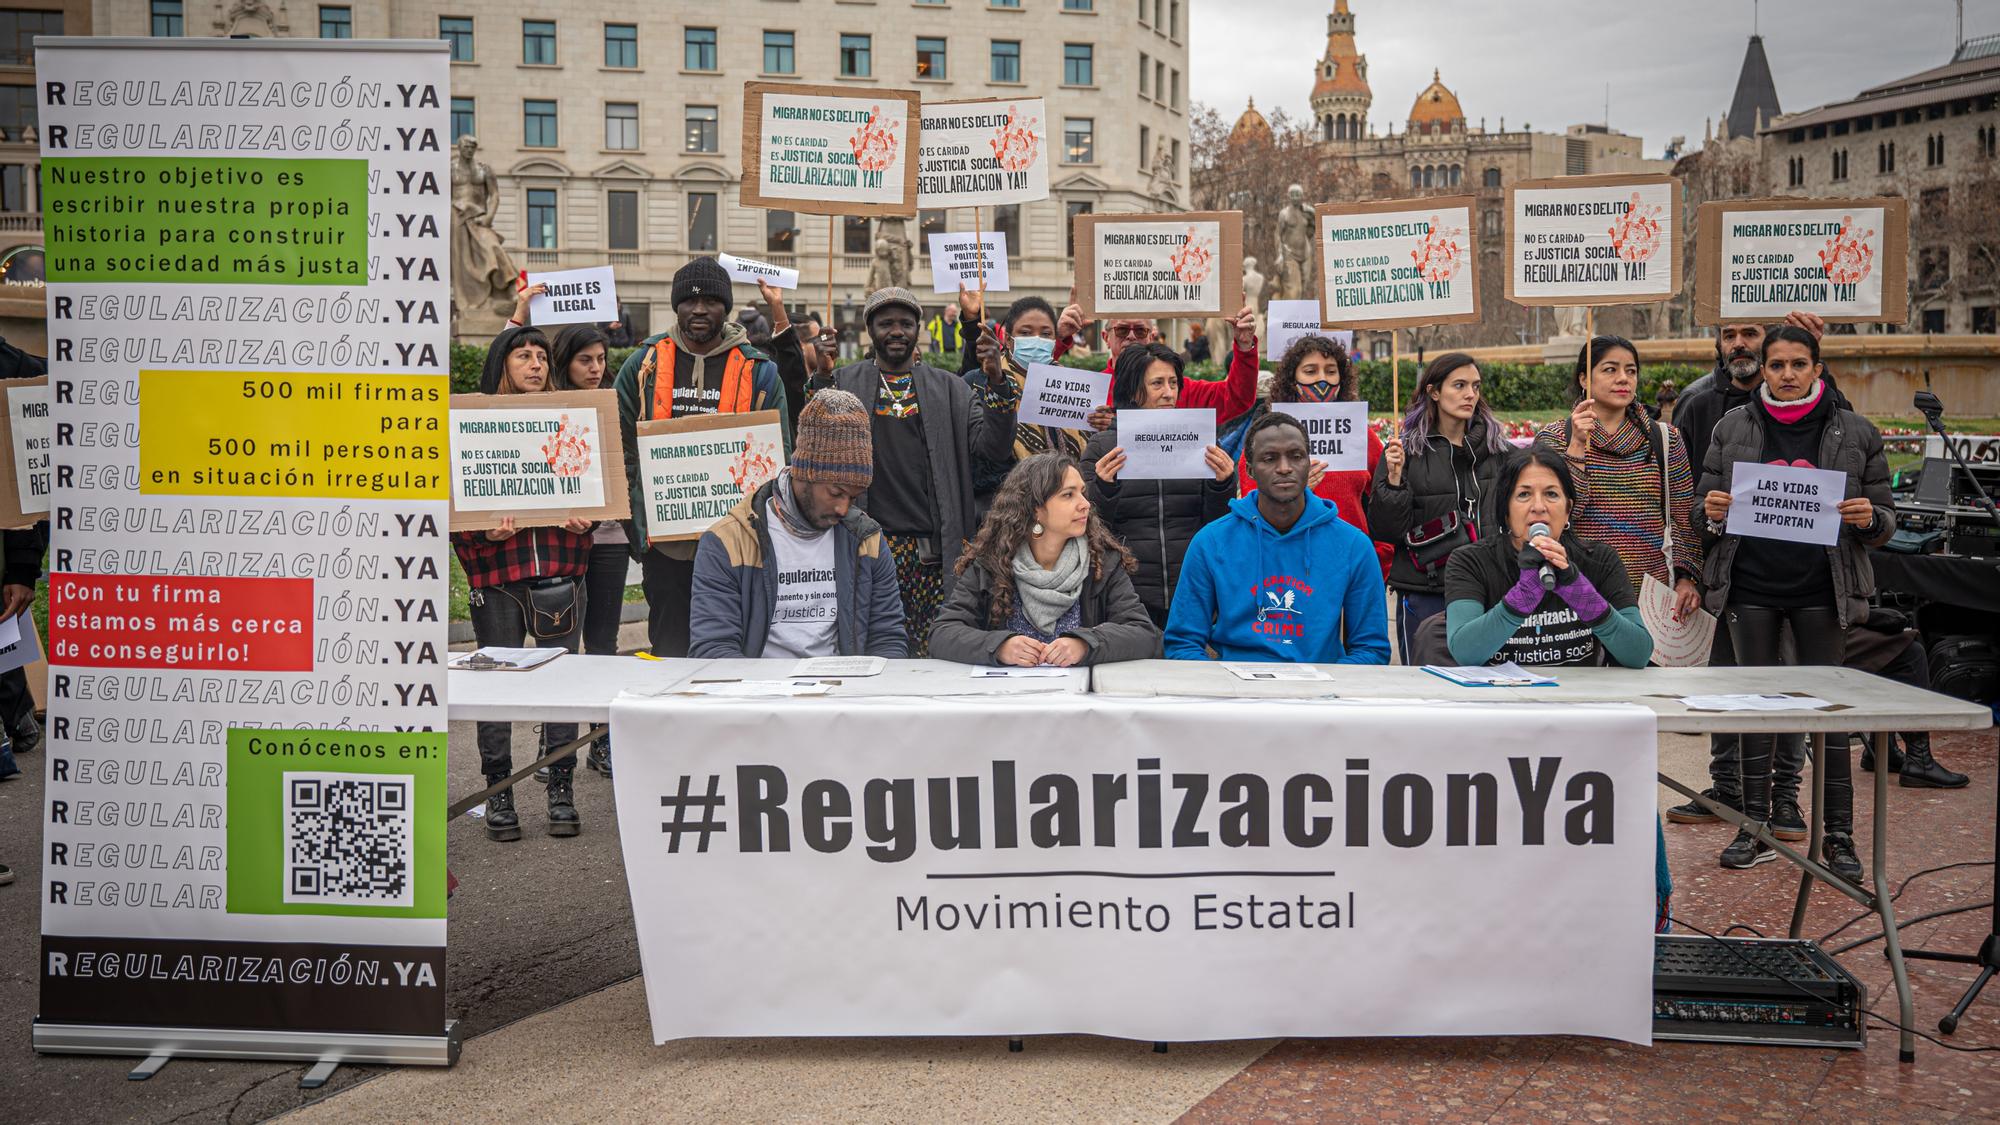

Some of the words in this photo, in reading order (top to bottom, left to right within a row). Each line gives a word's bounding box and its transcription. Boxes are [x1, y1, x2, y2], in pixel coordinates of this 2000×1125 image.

[46, 76, 440, 109] REGULARIZACIÓN.YA
[773, 106, 808, 120] MIGRAR
[809, 108, 822, 120] NO
[823, 109, 835, 121] ES
[837, 110, 870, 123] DELITO
[48, 119, 440, 152] REGULARIZACIÓN.YA
[771, 136, 782, 145] NO
[784, 136, 792, 145] ES
[795, 137, 828, 147] CARIDAD
[771, 151, 779, 160] ES
[781, 149, 823, 163] JUSTICIA
[827, 152, 861, 165] SOCIAL
[51, 166, 146, 185] Nuestro
[159, 166, 263, 189] objetivo
[277, 172, 304, 186] es
[770, 165, 857, 187] REGULARIZACION
[863, 170, 883, 189] YA!!
[52, 195, 145, 214] escribir
[158, 197, 255, 214] nuestra
[270, 197, 349, 219] propia
[1525, 203, 1563, 216] MIGRAR
[1564, 203, 1577, 215] NO
[1579, 203, 1592, 215] ES
[1594, 202, 1629, 215] DELITO
[53, 224, 145, 243] historia
[159, 228, 215, 247] para
[228, 227, 345, 245] construir
[1105, 234, 1135, 244] MIGRAR
[1136, 235, 1146, 244] NO
[1148, 235, 1158, 244] ES
[1160, 235, 1187, 244] DELITO
[1332, 227, 1368, 241] MIGRAR
[1369, 226, 1382, 238] NO
[1383, 225, 1396, 237] ES
[1397, 223, 1430, 237] DELITO
[1525, 234, 1536, 244] NO
[1538, 234, 1547, 243] ES
[1549, 233, 1585, 243] CARIDAD
[1734, 224, 1772, 237] MIGRAR
[1774, 224, 1787, 236] NO
[1789, 224, 1802, 236] ES
[1804, 223, 1840, 236] DELITO
[1334, 259, 1345, 268] NO
[1347, 258, 1355, 267] ES
[1357, 255, 1391, 267] CARIDAD
[1525, 250, 1533, 259] ES
[1535, 247, 1580, 260] JUSTICIA
[1585, 246, 1621, 259] SOCIAL
[1733, 255, 1744, 264] NO
[1746, 255, 1755, 264] ES
[1758, 254, 1794, 264] CARIDAD
[55, 258, 95, 272] una
[106, 253, 219, 272] sociedad
[233, 254, 286, 273] más
[297, 256, 359, 278] justa
[737, 264, 780, 276] IMPORTAN
[1525, 262, 1618, 283] REGULARIZACION
[1625, 262, 1646, 281] YA!!
[1732, 271, 1741, 280] ES
[1743, 267, 1789, 280] JUSTICIA
[1794, 267, 1831, 279] SOCIAL
[1104, 273, 1111, 281] ES
[1113, 271, 1148, 281] JUSTICIA
[1153, 271, 1181, 281] SOCIAL
[1335, 274, 1344, 284] ES
[1345, 269, 1388, 284] JUSTICIA
[1392, 266, 1426, 280] SOCIAL
[545, 282, 582, 297] NADIE
[586, 281, 601, 295] ES
[1104, 285, 1178, 300] REGULARIZACION
[1184, 285, 1200, 300] YA!!
[1336, 282, 1425, 307] REGULARIZACION
[1430, 280, 1450, 300] YA!!
[1732, 283, 1828, 303] REGULARIZACION
[1834, 283, 1856, 301] YA!!
[55, 292, 439, 324] REGULARIZACIÓN.YA
[553, 299, 595, 312] ILEGAL
[55, 335, 439, 367] REGULARIZACIÓN.YA
[243, 380, 293, 399] 500
[307, 382, 341, 400] mil
[354, 382, 439, 402] firmas
[1045, 378, 1062, 389] LAS
[1065, 380, 1091, 393] VIDAS
[1040, 392, 1092, 408] MIGRANTES
[1038, 406, 1085, 420] IMPORTAN
[381, 416, 438, 434] para
[460, 422, 497, 433] MIGRAR
[498, 422, 511, 433] NO
[512, 422, 526, 433] ES
[527, 421, 560, 433] DELITO
[208, 438, 256, 456] 500
[270, 439, 310, 457] mil
[323, 444, 439, 462] personas
[461, 451, 473, 459] NO
[475, 450, 484, 459] ES
[486, 450, 521, 459] CARIDAD
[651, 446, 687, 460] MIGRAR
[687, 445, 700, 457] NO
[701, 444, 713, 456] ES
[714, 441, 747, 455] DELITO
[462, 466, 472, 474] ES
[473, 462, 518, 475] JUSTICIA
[522, 462, 556, 474] SOCIAL
[151, 470, 180, 484] en
[193, 467, 314, 486] situación
[327, 469, 440, 492] irregular
[463, 477, 555, 497] REGULARIZACION
[560, 477, 581, 494] YA!!
[653, 476, 665, 485] NO
[666, 475, 674, 484] ES
[676, 472, 710, 483] CARIDAD
[1757, 479, 1778, 493] LAS
[1783, 482, 1819, 496] VIDAS
[655, 491, 664, 500] ES
[664, 485, 707, 500] JUSTICIA
[710, 483, 744, 496] SOCIAL
[1751, 496, 1821, 513] MIGRANTES
[57, 505, 438, 538] REGULARIZACIÓN.YA
[1753, 512, 1814, 530] IMPORTAN
[57, 582, 104, 604] ¡Con
[116, 584, 139, 602] tu
[152, 584, 221, 604] firma
[56, 612, 156, 631] estamos
[169, 613, 220, 632] más
[231, 619, 302, 634] cerca
[1252, 621, 1304, 637] CRIME
[56, 639, 79, 657] de
[90, 642, 249, 664] conseguirlo!
[1514, 648, 1561, 663] justicia
[55, 673, 438, 707] REGULARIZACIÓN.YA
[248, 737, 386, 759] Conócenos
[399, 745, 437, 759] en:
[660, 756, 1615, 863] #RegularizacionYa
[896, 892, 1170, 933] Movimiento
[1194, 891, 1354, 931] Estatal
[48, 952, 437, 988] REGULARIZACIÓN.YA
